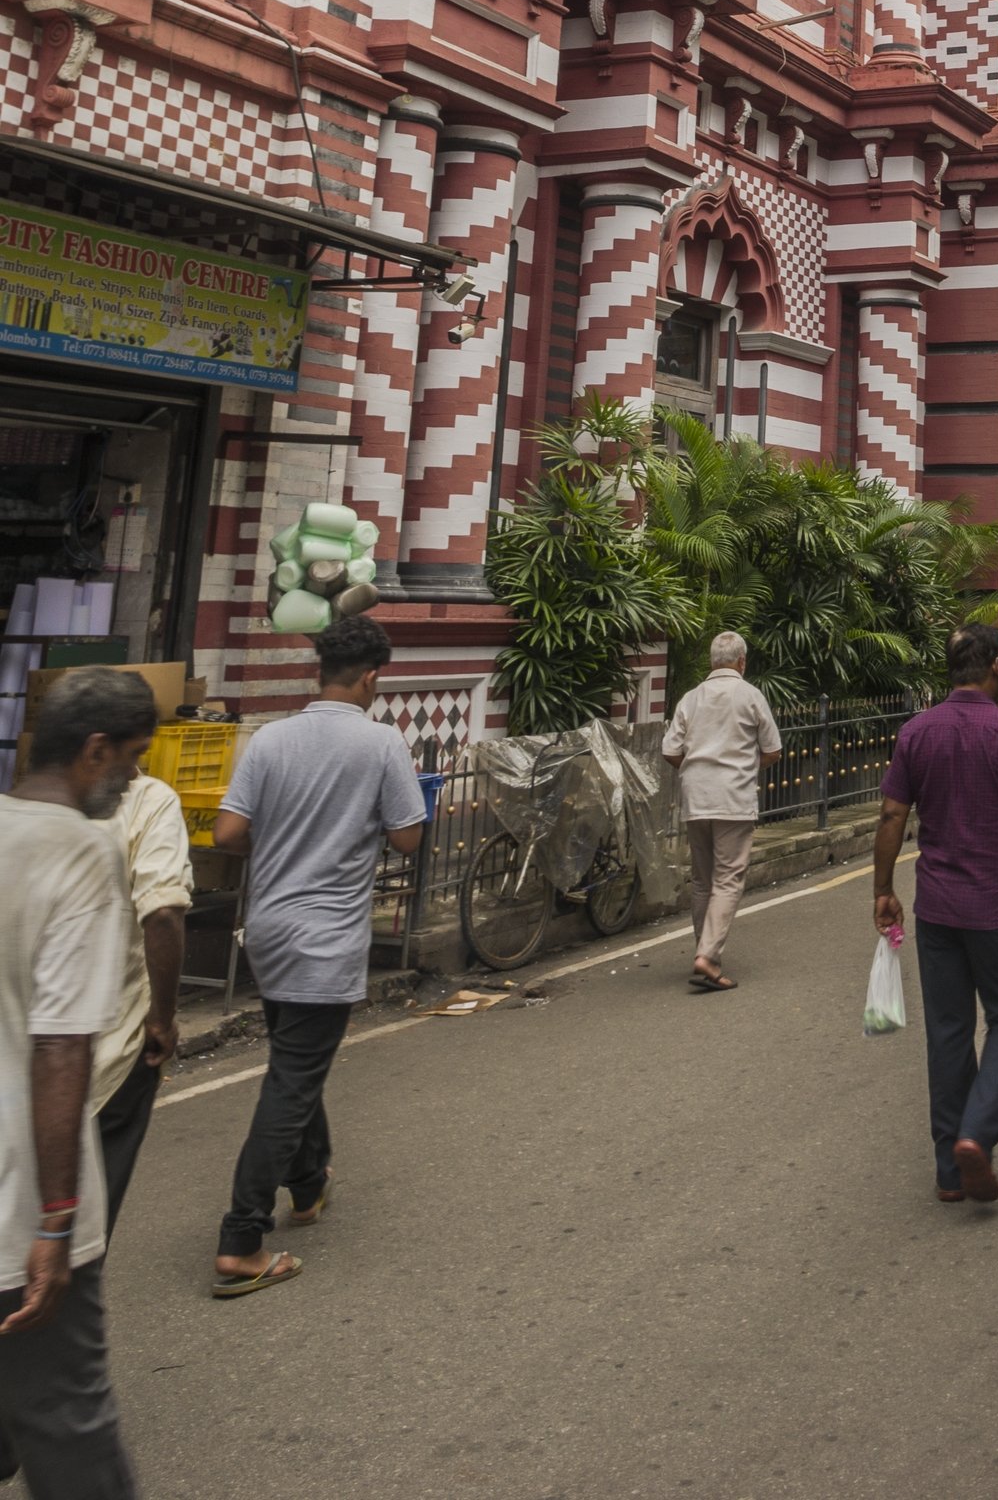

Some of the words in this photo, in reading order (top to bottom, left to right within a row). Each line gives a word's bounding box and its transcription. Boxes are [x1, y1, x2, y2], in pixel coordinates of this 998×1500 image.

[62, 230, 176, 280] FASHION
[182, 259, 270, 301] CENTRE
[52, 288, 89, 309] Beads,
[93, 296, 123, 316] Wool,
[160, 309, 177, 327] Zip
[179, 317, 189, 327] &
[192, 315, 221, 332] Fancy
[222, 321, 254, 338] Goods
[69, 272, 97, 291] Lace,
[101, 278, 135, 298] Strips,
[138, 285, 183, 305] Ribbons,
[187, 295, 204, 310] Bra
[207, 297, 231, 316] Item,
[233, 304, 268, 323] Coards,
[62, 339, 83, 353] Tel:
[83, 343, 105, 358] 0773
